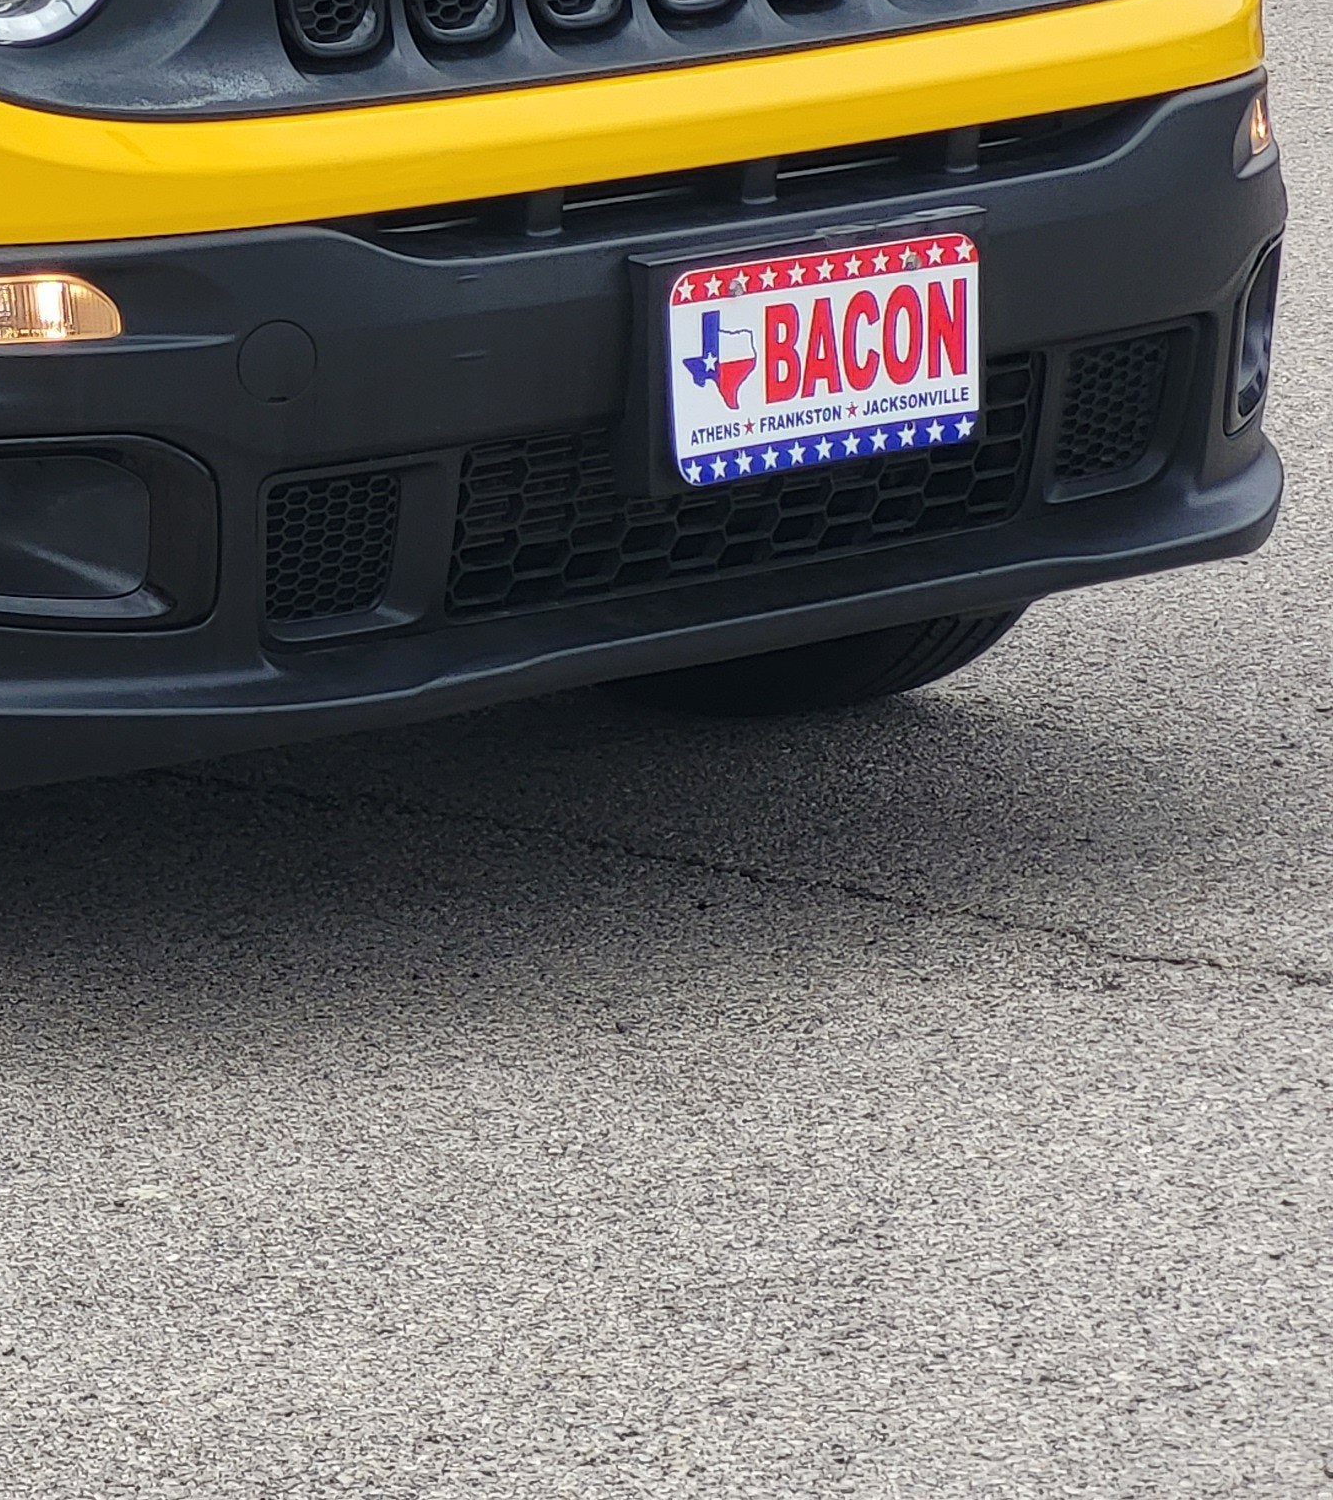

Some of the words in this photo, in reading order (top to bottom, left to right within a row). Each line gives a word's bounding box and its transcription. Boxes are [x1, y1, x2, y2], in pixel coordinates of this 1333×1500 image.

[765, 277, 969, 405] BACON
[690, 420, 742, 447] ATHENS
[759, 405, 842, 434] FRANKSTON
[862, 386, 970, 417] JACKSONVILLE
